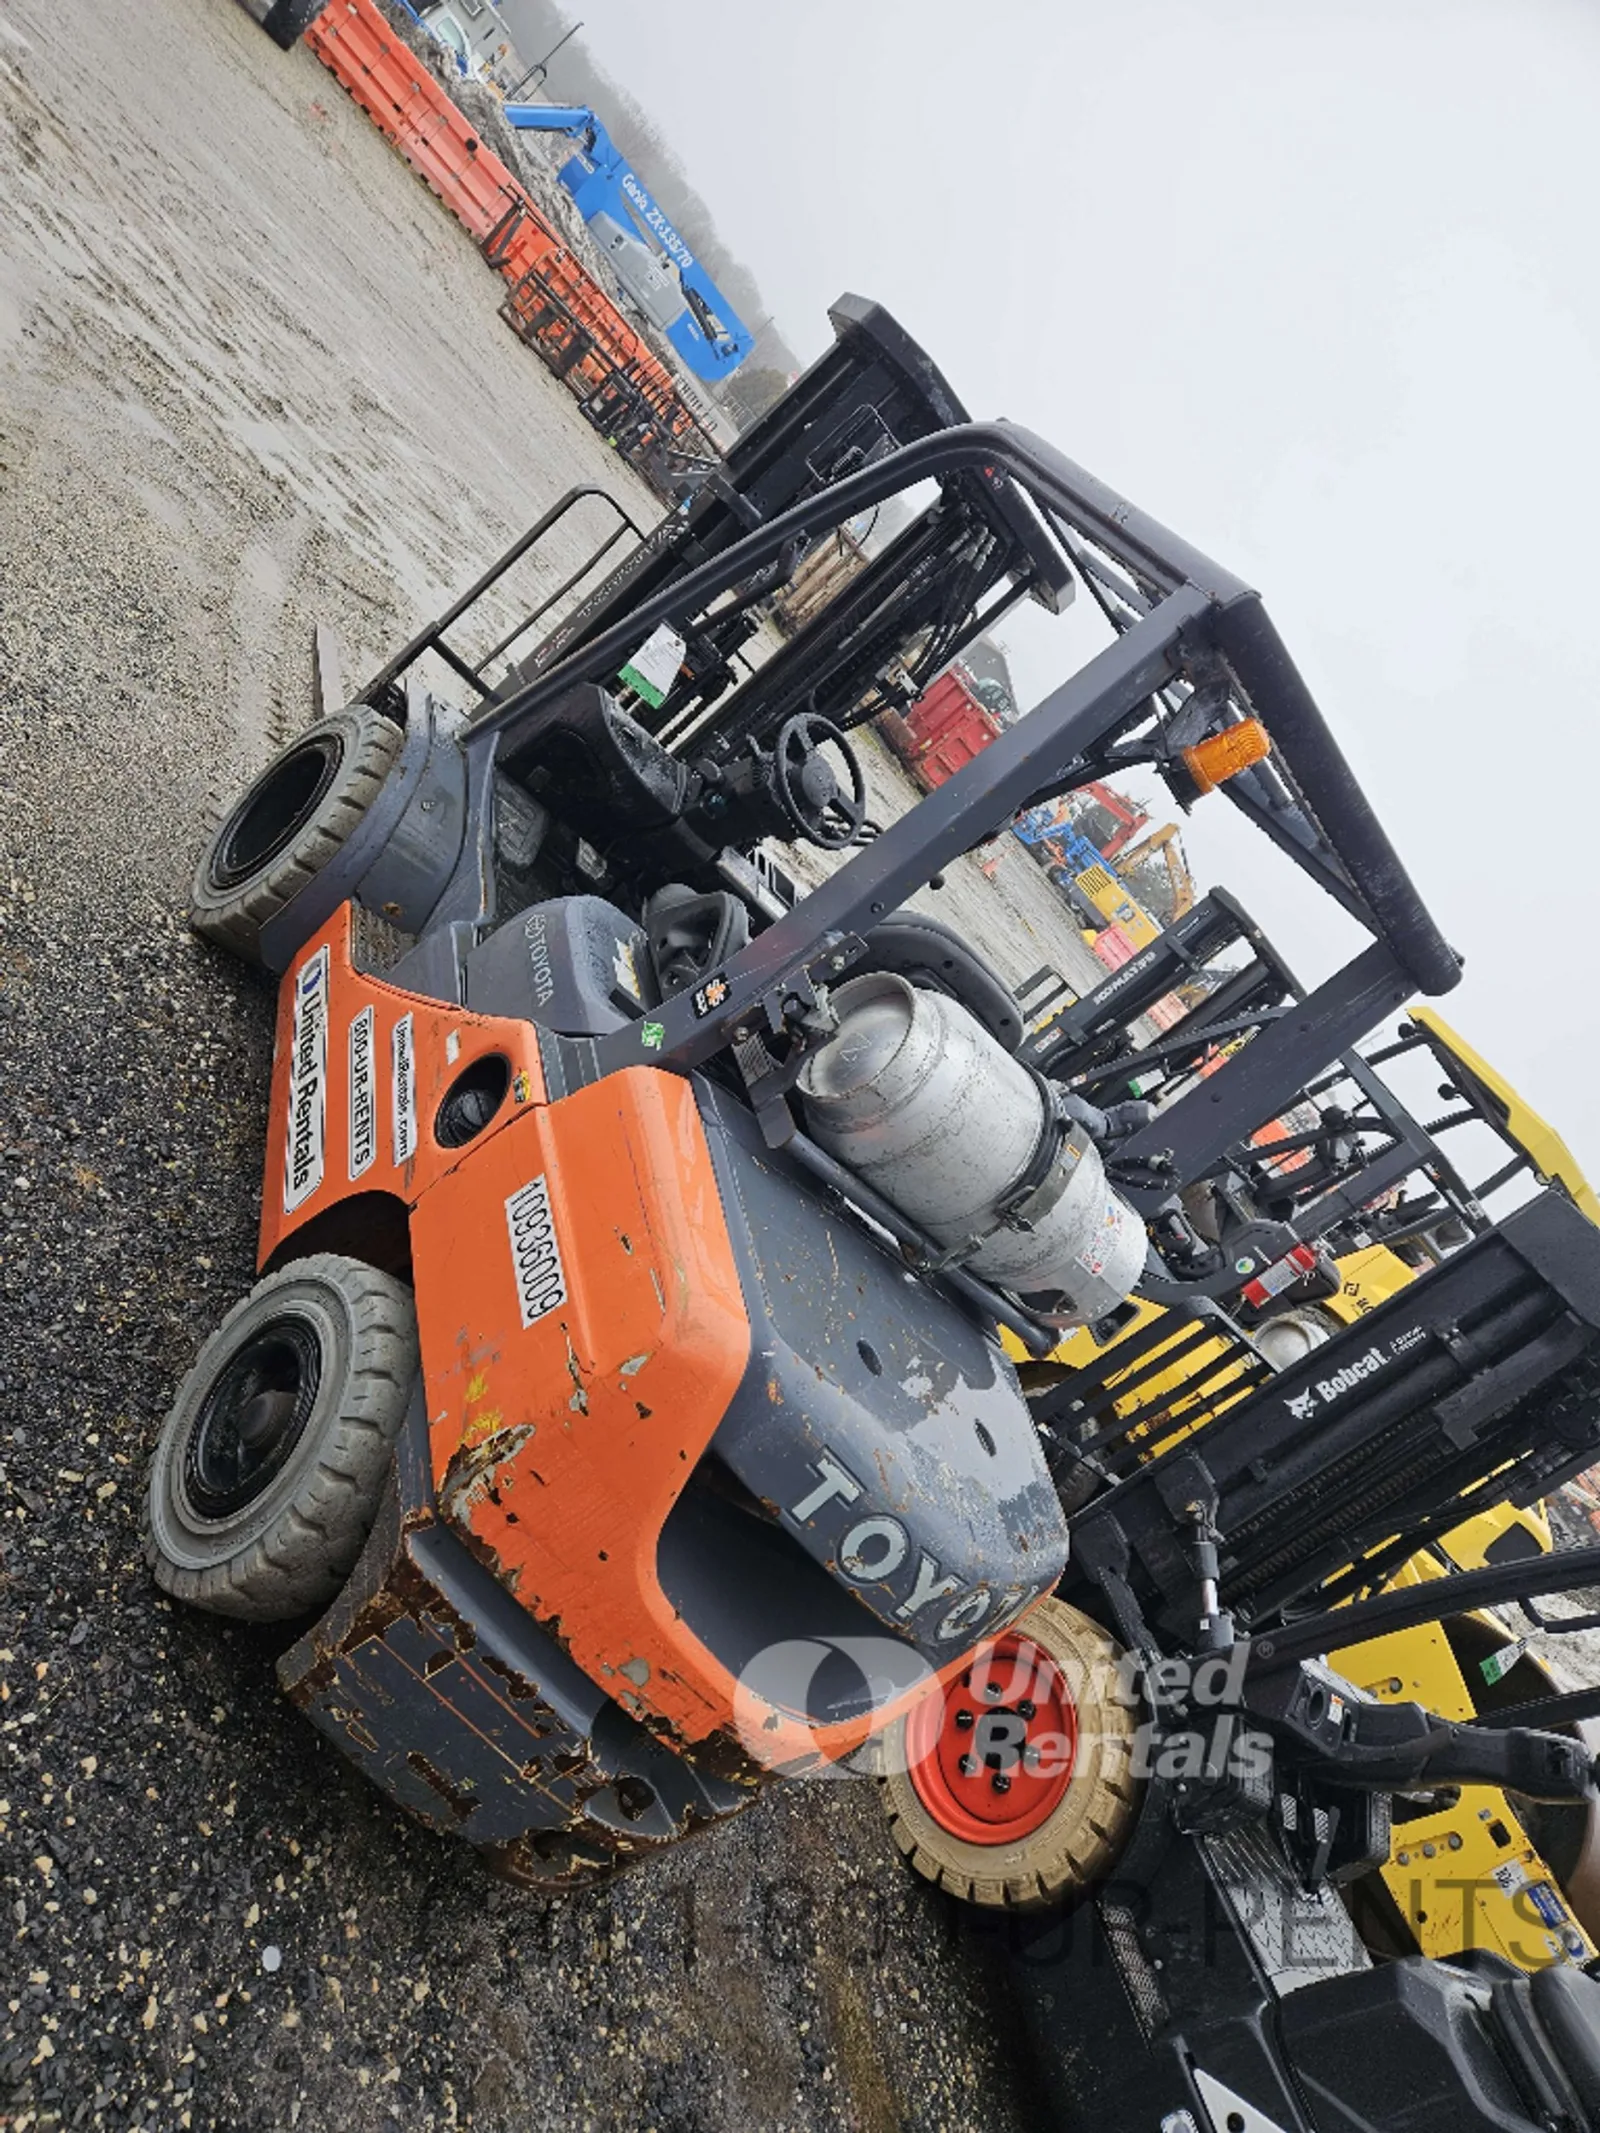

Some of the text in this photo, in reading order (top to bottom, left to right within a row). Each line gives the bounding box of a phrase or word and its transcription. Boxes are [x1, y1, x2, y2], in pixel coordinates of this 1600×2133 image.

[622, 174, 648, 211] Genie
[645, 207, 693, 267] ZX-135/70
[529, 938, 554, 1007] TOYOTA
[1093, 951, 1157, 1006] KOMATSU
[293, 991, 323, 1191] United Rentals
[353, 1019, 371, 1167] 800-UR-RENTS
[511, 1181, 563, 1319] 10936009
[1315, 1347, 1390, 1403] Bobcat
